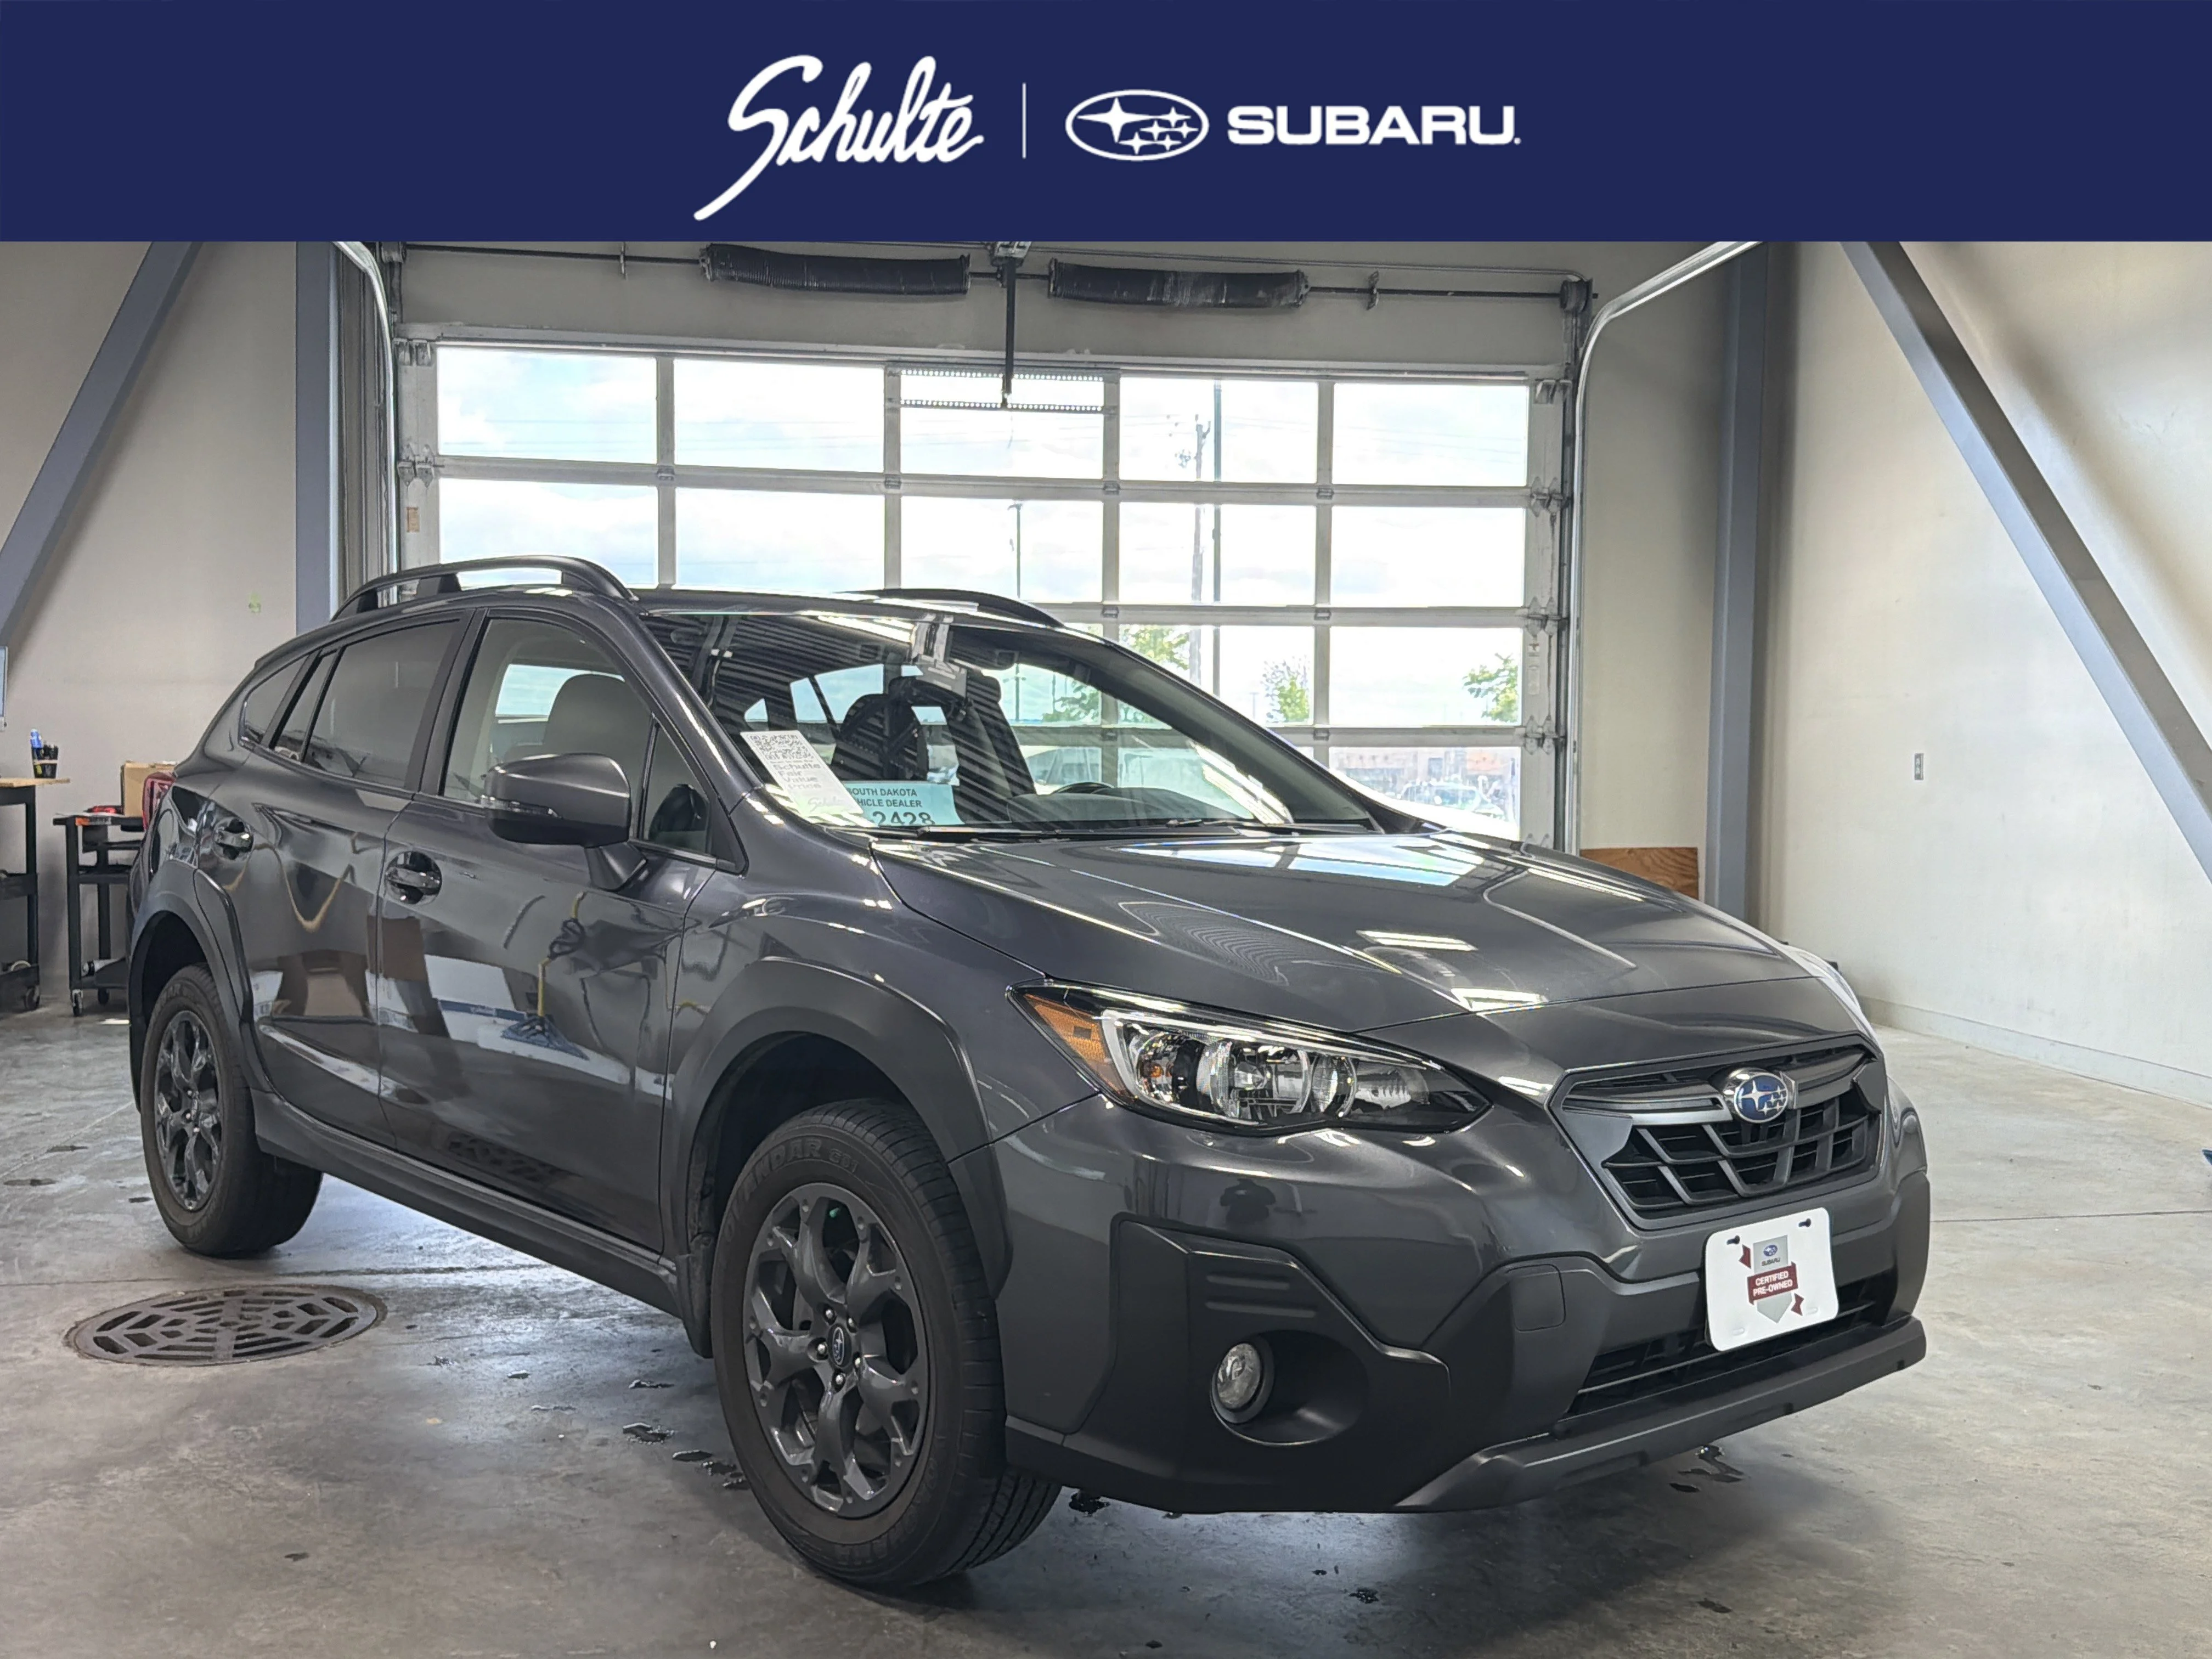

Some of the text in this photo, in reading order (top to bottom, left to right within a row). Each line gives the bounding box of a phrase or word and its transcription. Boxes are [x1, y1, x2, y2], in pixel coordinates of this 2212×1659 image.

[854, 798, 923, 808] HICLE DEALER
[1755, 1270, 1789, 1286] CERTIFIED
[1753, 1279, 1793, 1297] PRE-OWNED
